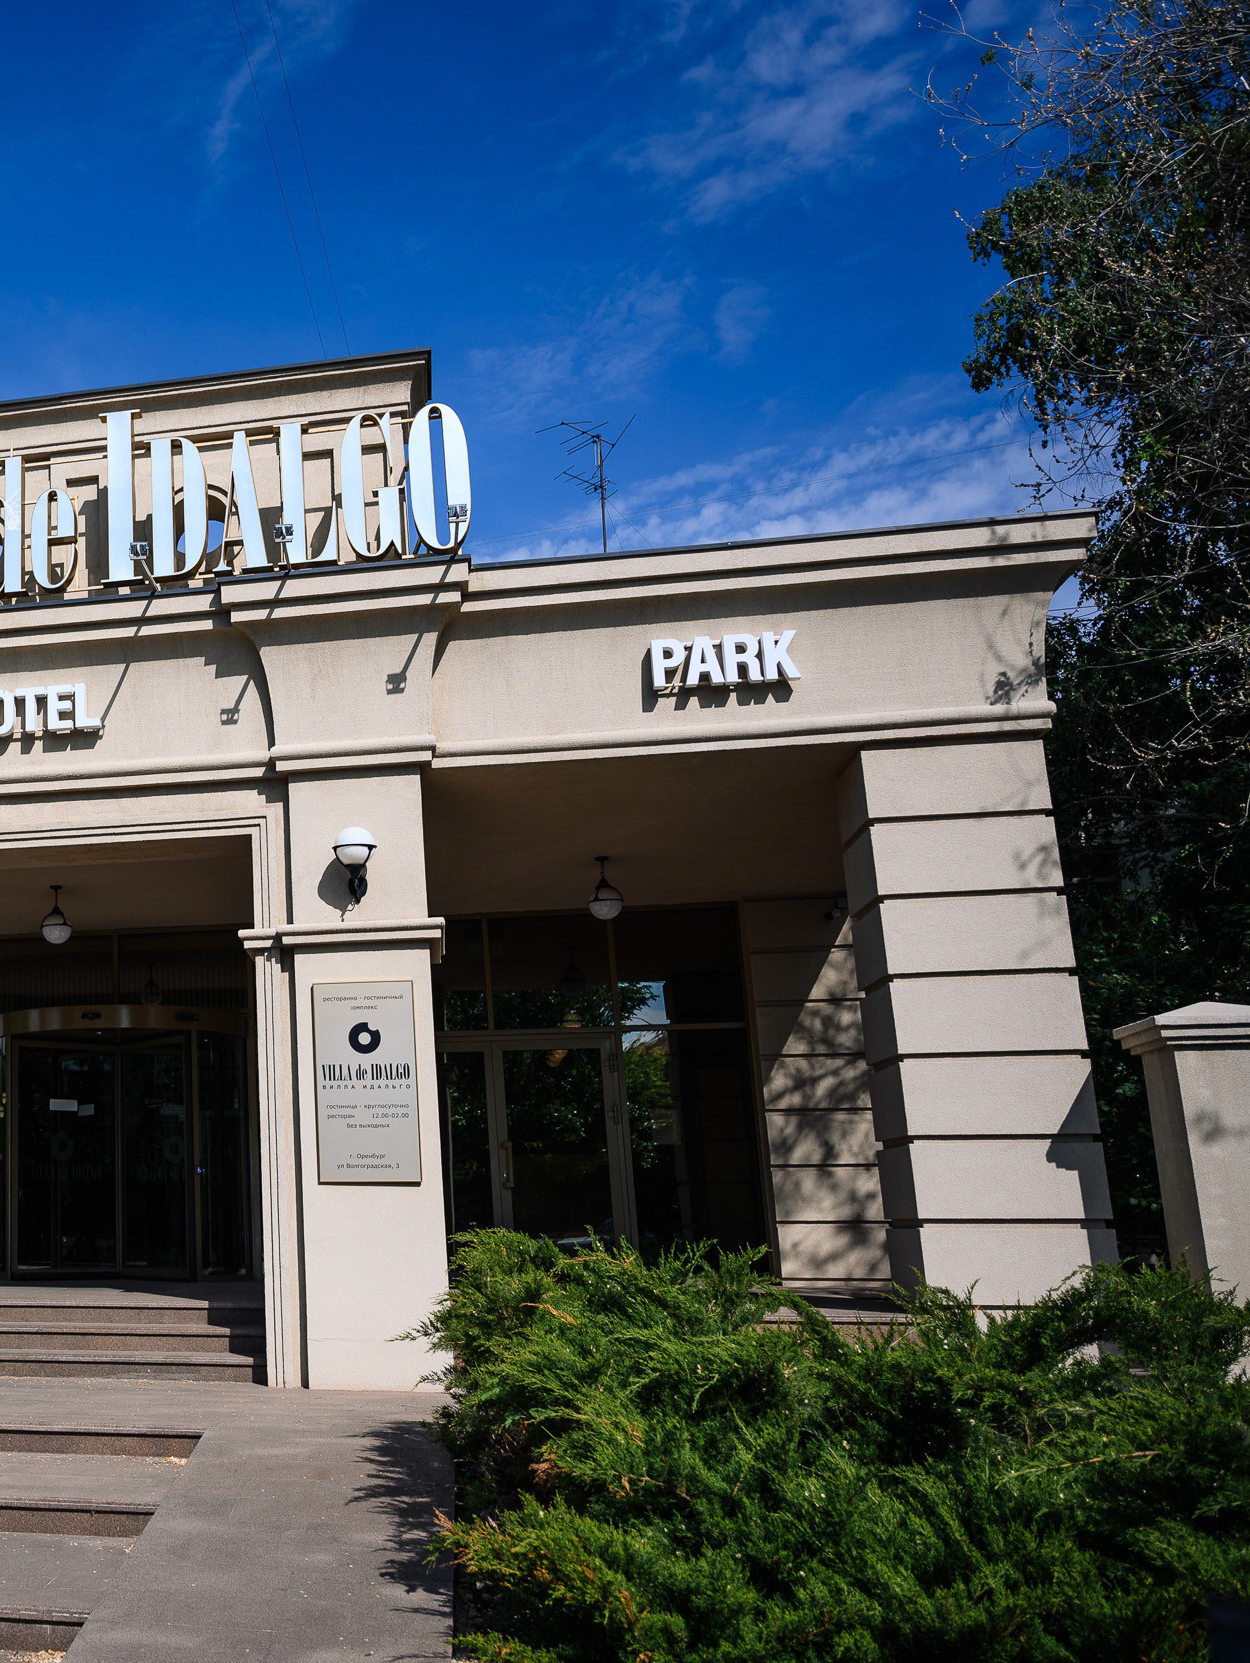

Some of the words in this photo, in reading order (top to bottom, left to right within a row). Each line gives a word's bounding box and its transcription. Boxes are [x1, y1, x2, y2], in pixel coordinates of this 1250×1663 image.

[98, 402, 472, 586] IDALGO
[650, 629, 802, 691] PARK
[321, 1063, 352, 1082] VILLA
[355, 1063, 368, 1081] de
[370, 1062, 410, 1081] IDALGO
[327, 1112, 356, 1120] ресторан
[346, 1162, 393, 1170] Волгоградская,
